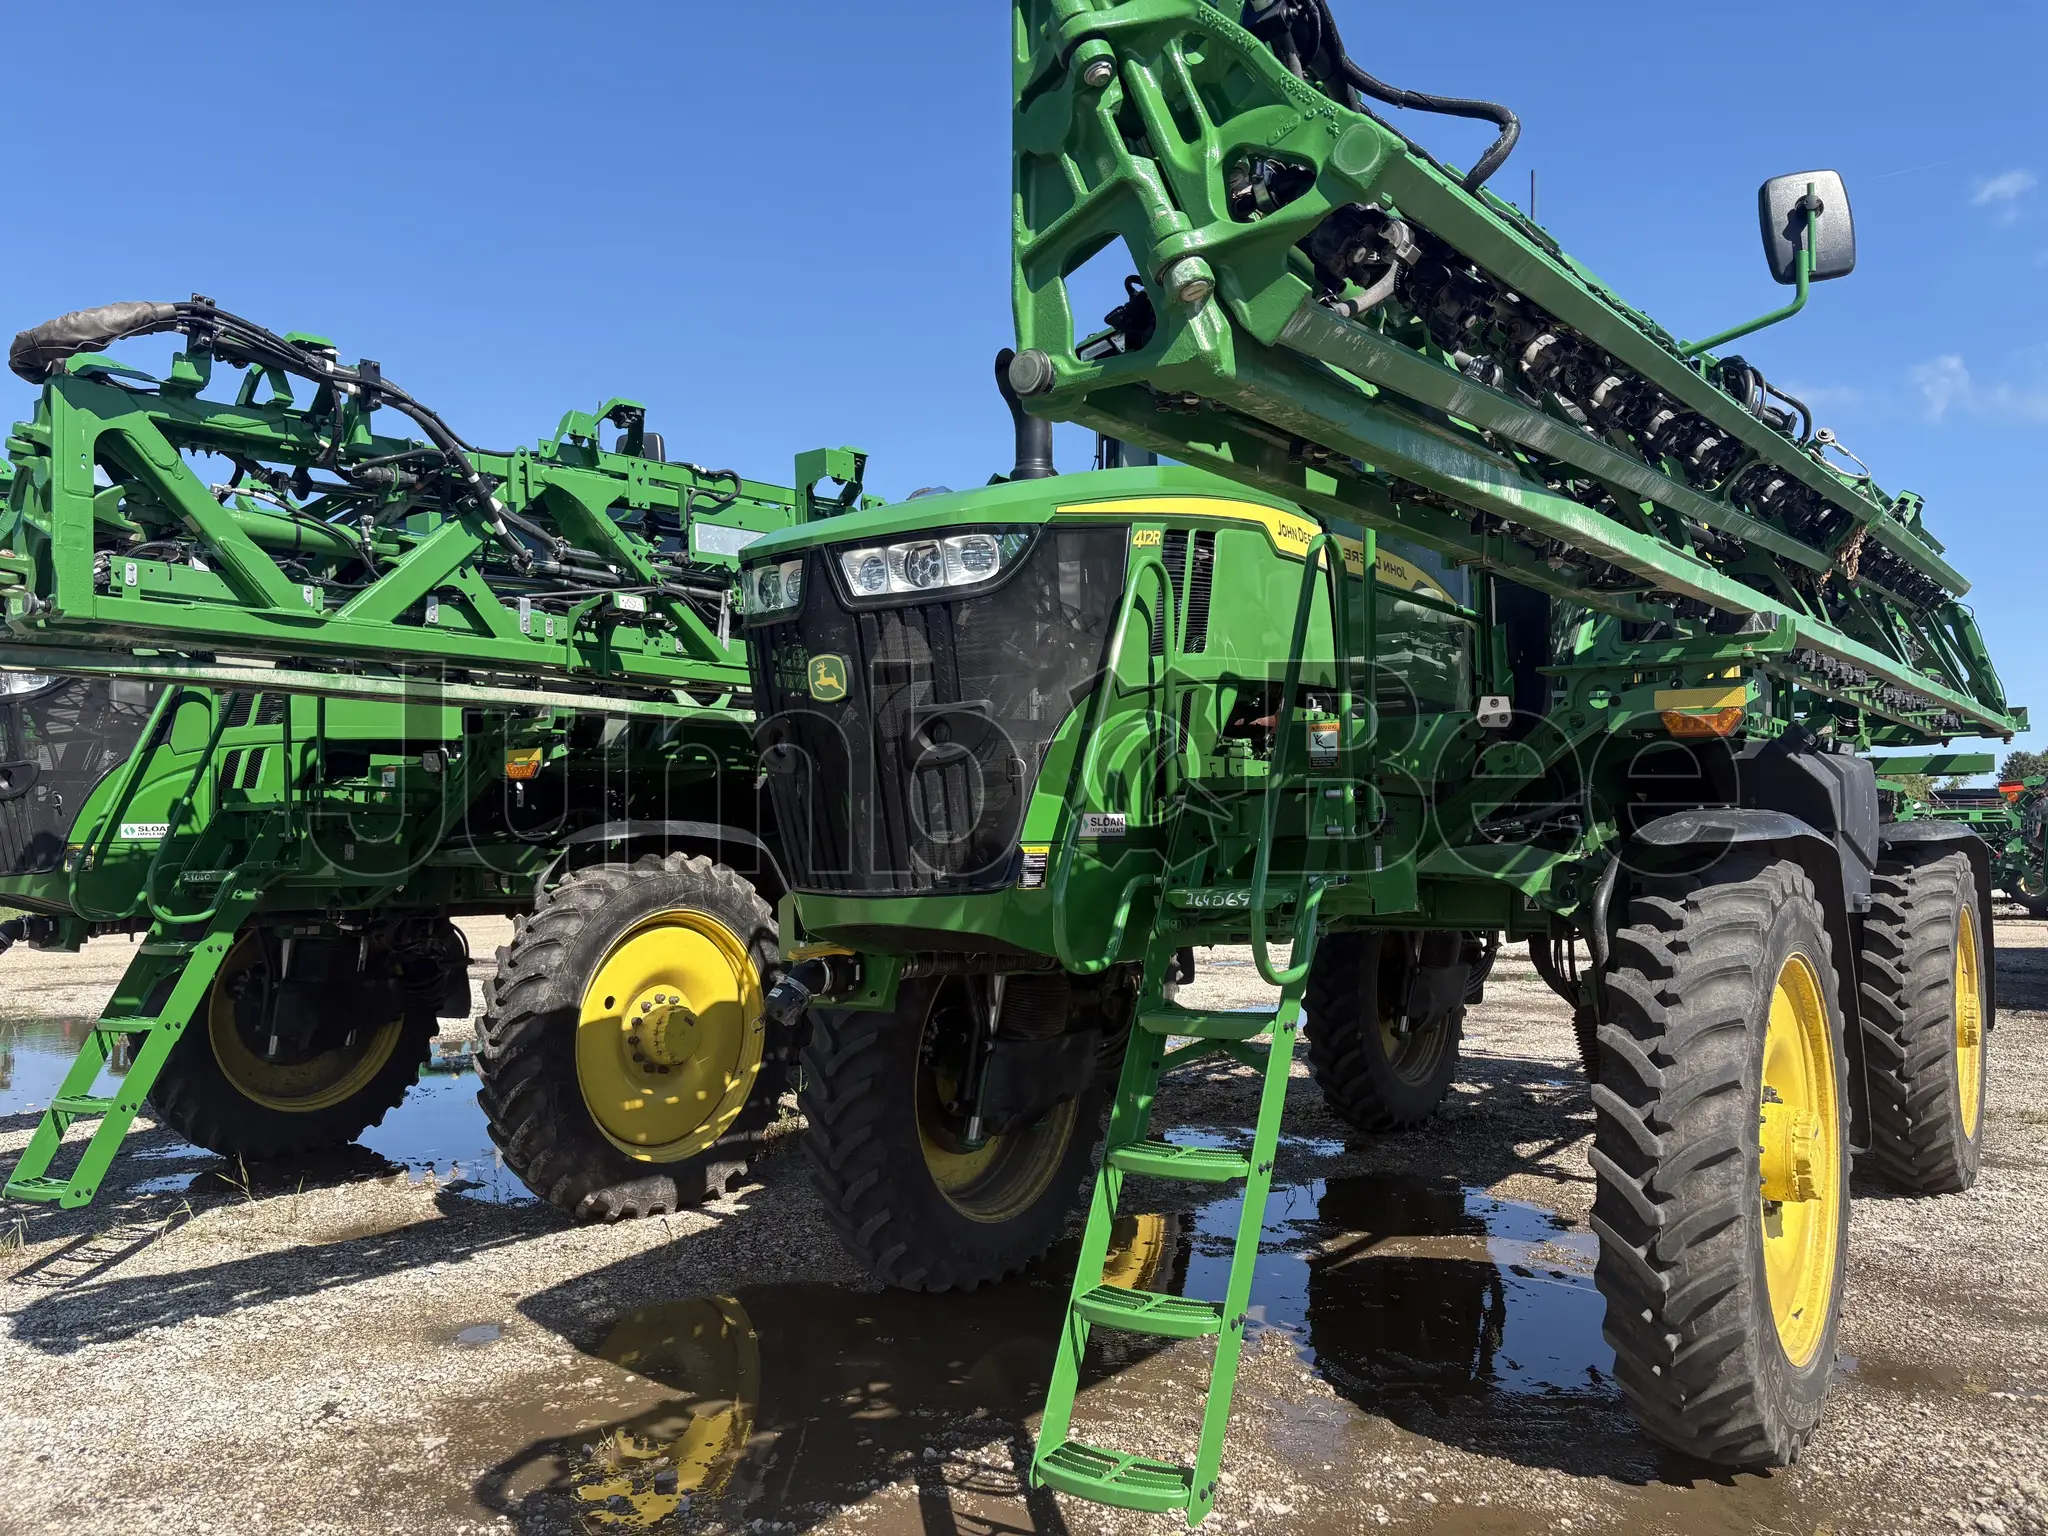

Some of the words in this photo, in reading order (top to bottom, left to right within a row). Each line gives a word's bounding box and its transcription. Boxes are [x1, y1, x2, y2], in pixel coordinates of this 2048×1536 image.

[1132, 529, 1161, 549] 412R
[1278, 520, 1298, 541] JOHN
[1297, 527, 1314, 545] DEE
[1090, 817, 1124, 827] SLOAN
